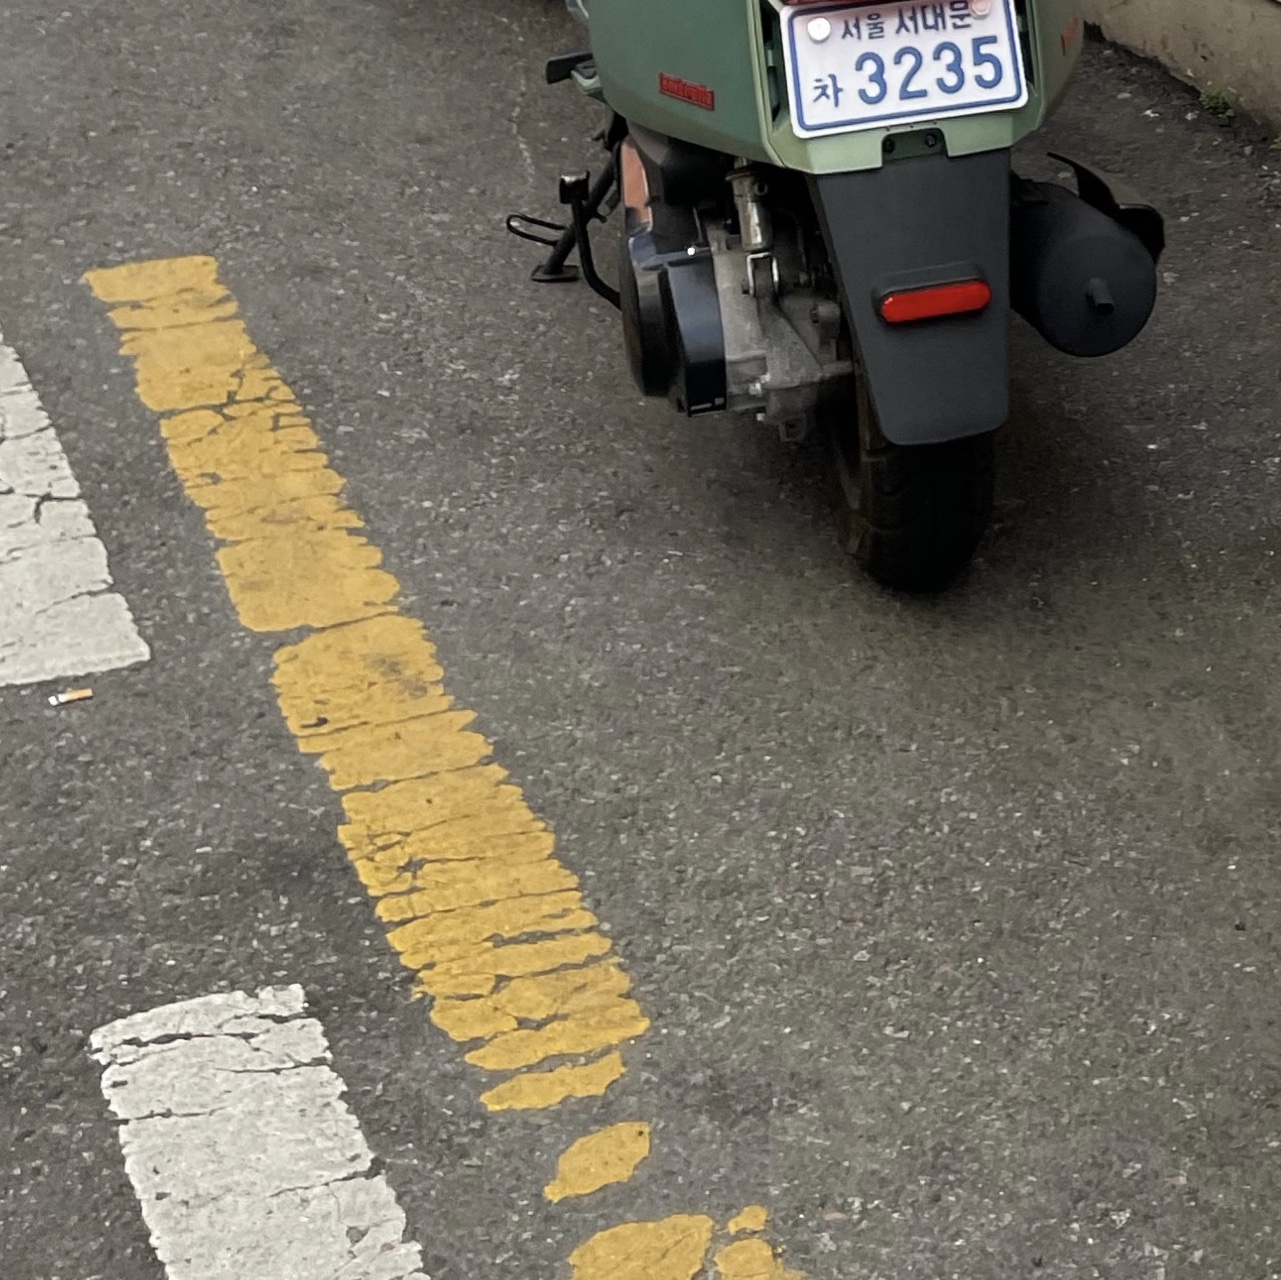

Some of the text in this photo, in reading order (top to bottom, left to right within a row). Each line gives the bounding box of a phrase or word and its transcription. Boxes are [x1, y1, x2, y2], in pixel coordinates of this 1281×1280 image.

[841, 0, 972, 41] 서울 서대문
[813, 73, 843, 108] 차
[855, 35, 1004, 105] 3235
